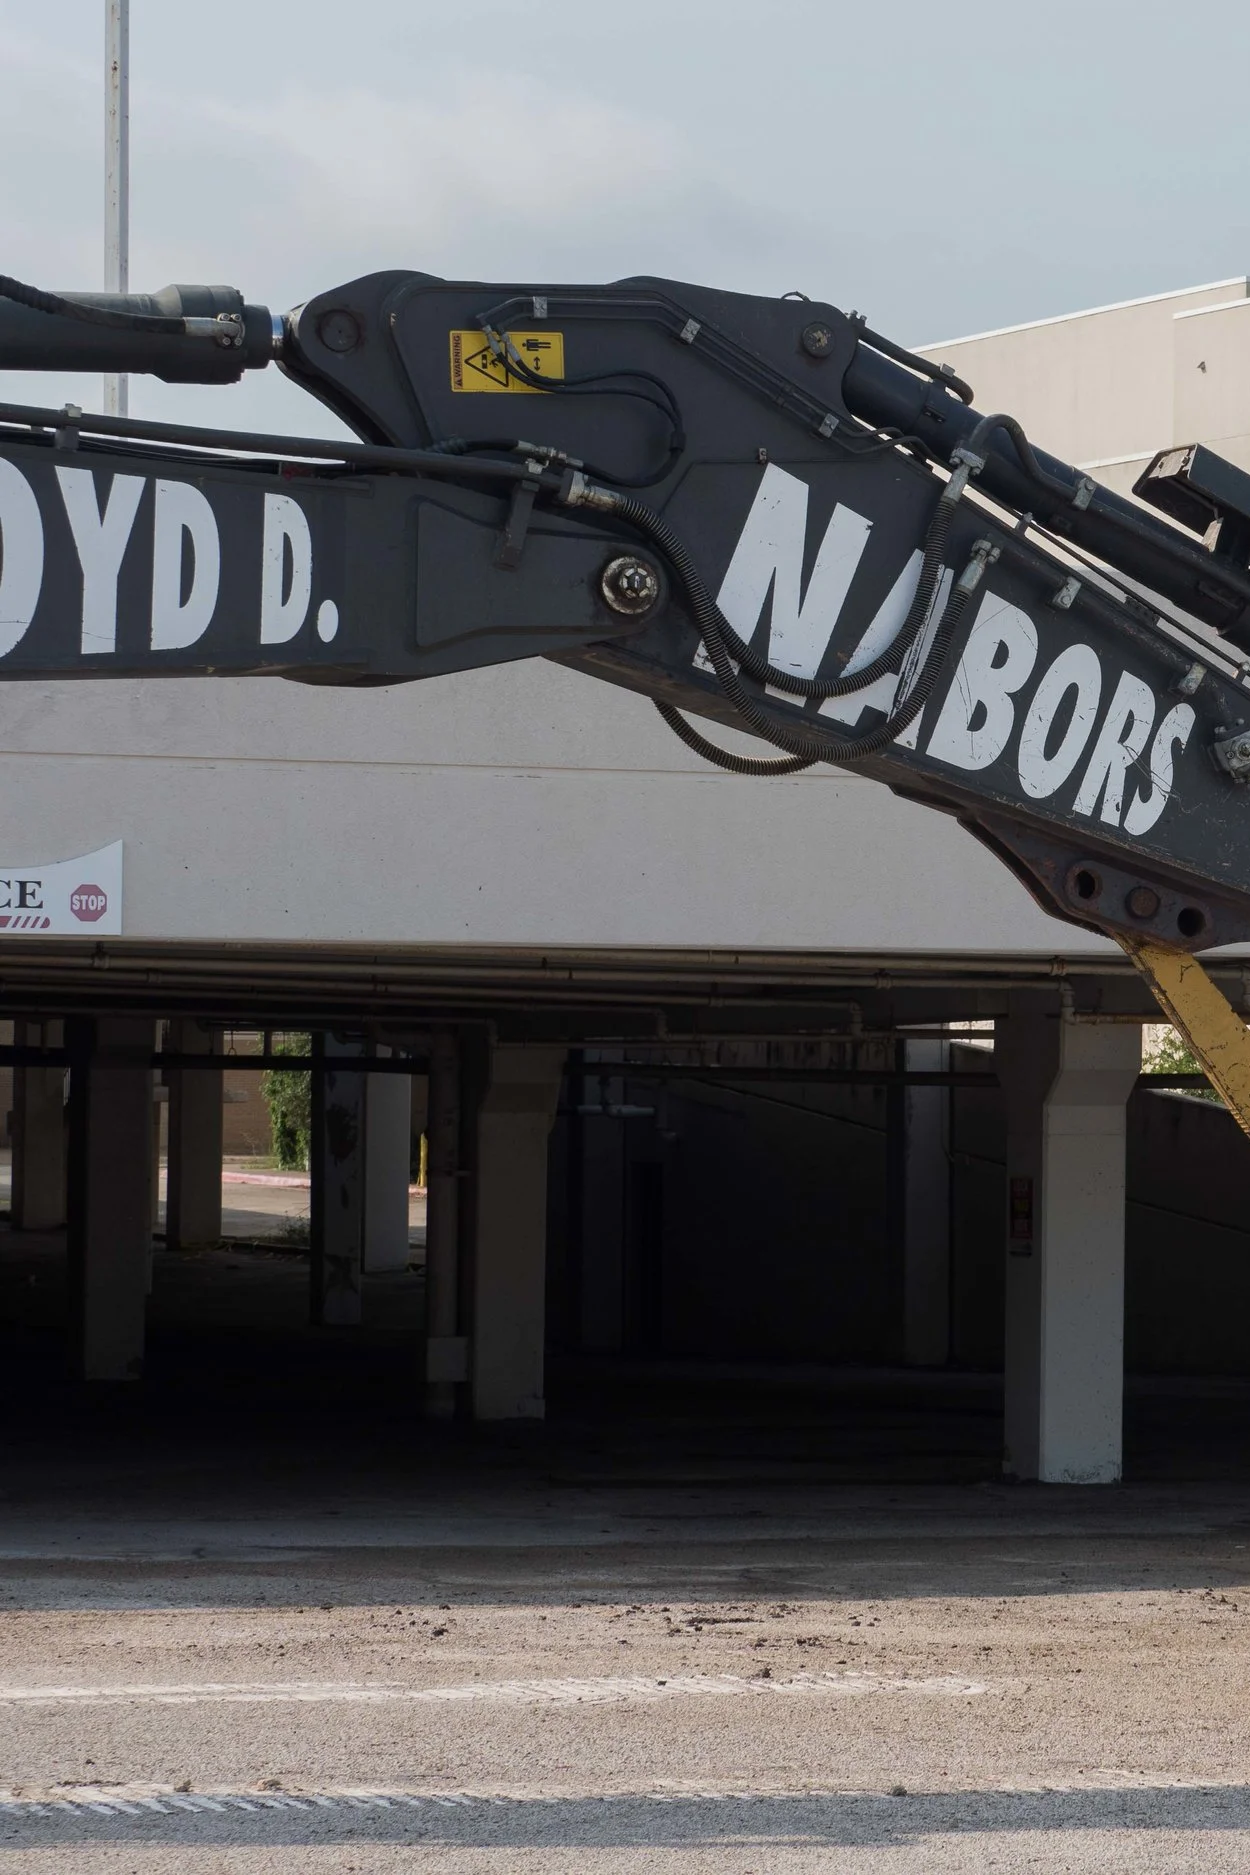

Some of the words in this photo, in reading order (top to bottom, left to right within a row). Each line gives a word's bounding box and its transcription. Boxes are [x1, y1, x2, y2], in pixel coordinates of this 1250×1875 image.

[260, 492, 339, 643] D.
[692, 463, 1197, 836] NABORS
[72, 894, 105, 911] STOP
